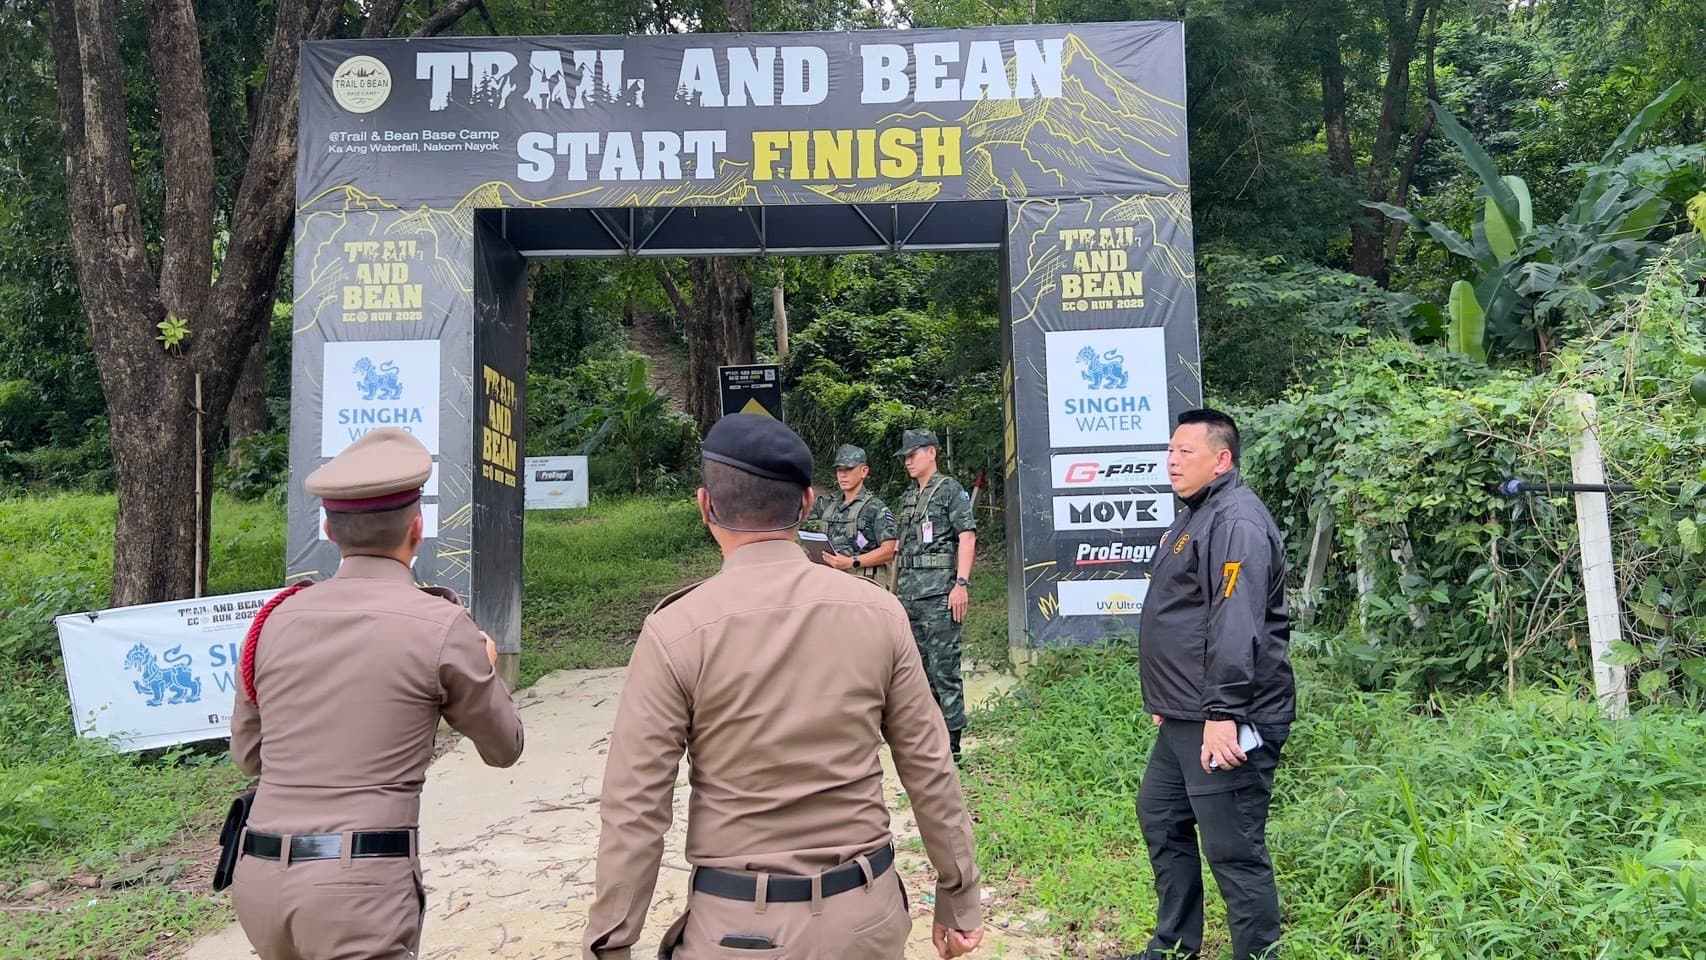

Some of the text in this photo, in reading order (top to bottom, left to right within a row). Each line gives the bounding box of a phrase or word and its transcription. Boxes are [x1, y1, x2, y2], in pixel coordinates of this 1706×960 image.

[335, 79, 358, 88] TRAIL
[366, 79, 389, 88] BEAN
[416, 38, 1063, 111] TRAIL AND BEAN
[329, 129, 500, 142] @Trail & Bean Base Camp
[328, 142, 499, 154] Ka Ang Waterfall, Nakorn Nayok
[516, 126, 963, 183] START FINISH
[1059, 226, 1142, 251] TRAIL
[344, 240, 424, 263] TRAIL
[1072, 249, 1127, 272] AND
[356, 262, 409, 285] AND
[1061, 271, 1143, 299] BEAN
[342, 284, 423, 310] BEAN
[1091, 300, 1113, 310] RUN
[1116, 299, 1144, 309] 2025
[370, 312, 393, 321] RUN
[395, 311, 423, 321] 2025
[483, 364, 518, 411] TRAIL
[1064, 395, 1151, 414] SINGHA
[338, 407, 422, 425] SINGHA
[488, 399, 512, 437] AND
[1076, 414, 1142, 432] WATER
[483, 425, 517, 472] BEAN
[1064, 462, 1158, 483] G-FAST
[1076, 542, 1157, 563] ProEngy
[1223, 561, 1242, 599] 7
[213, 603, 233, 613] AND
[237, 600, 265, 610] BEAN
[1096, 601, 1113, 610] UV
[212, 614, 232, 623] RUN
